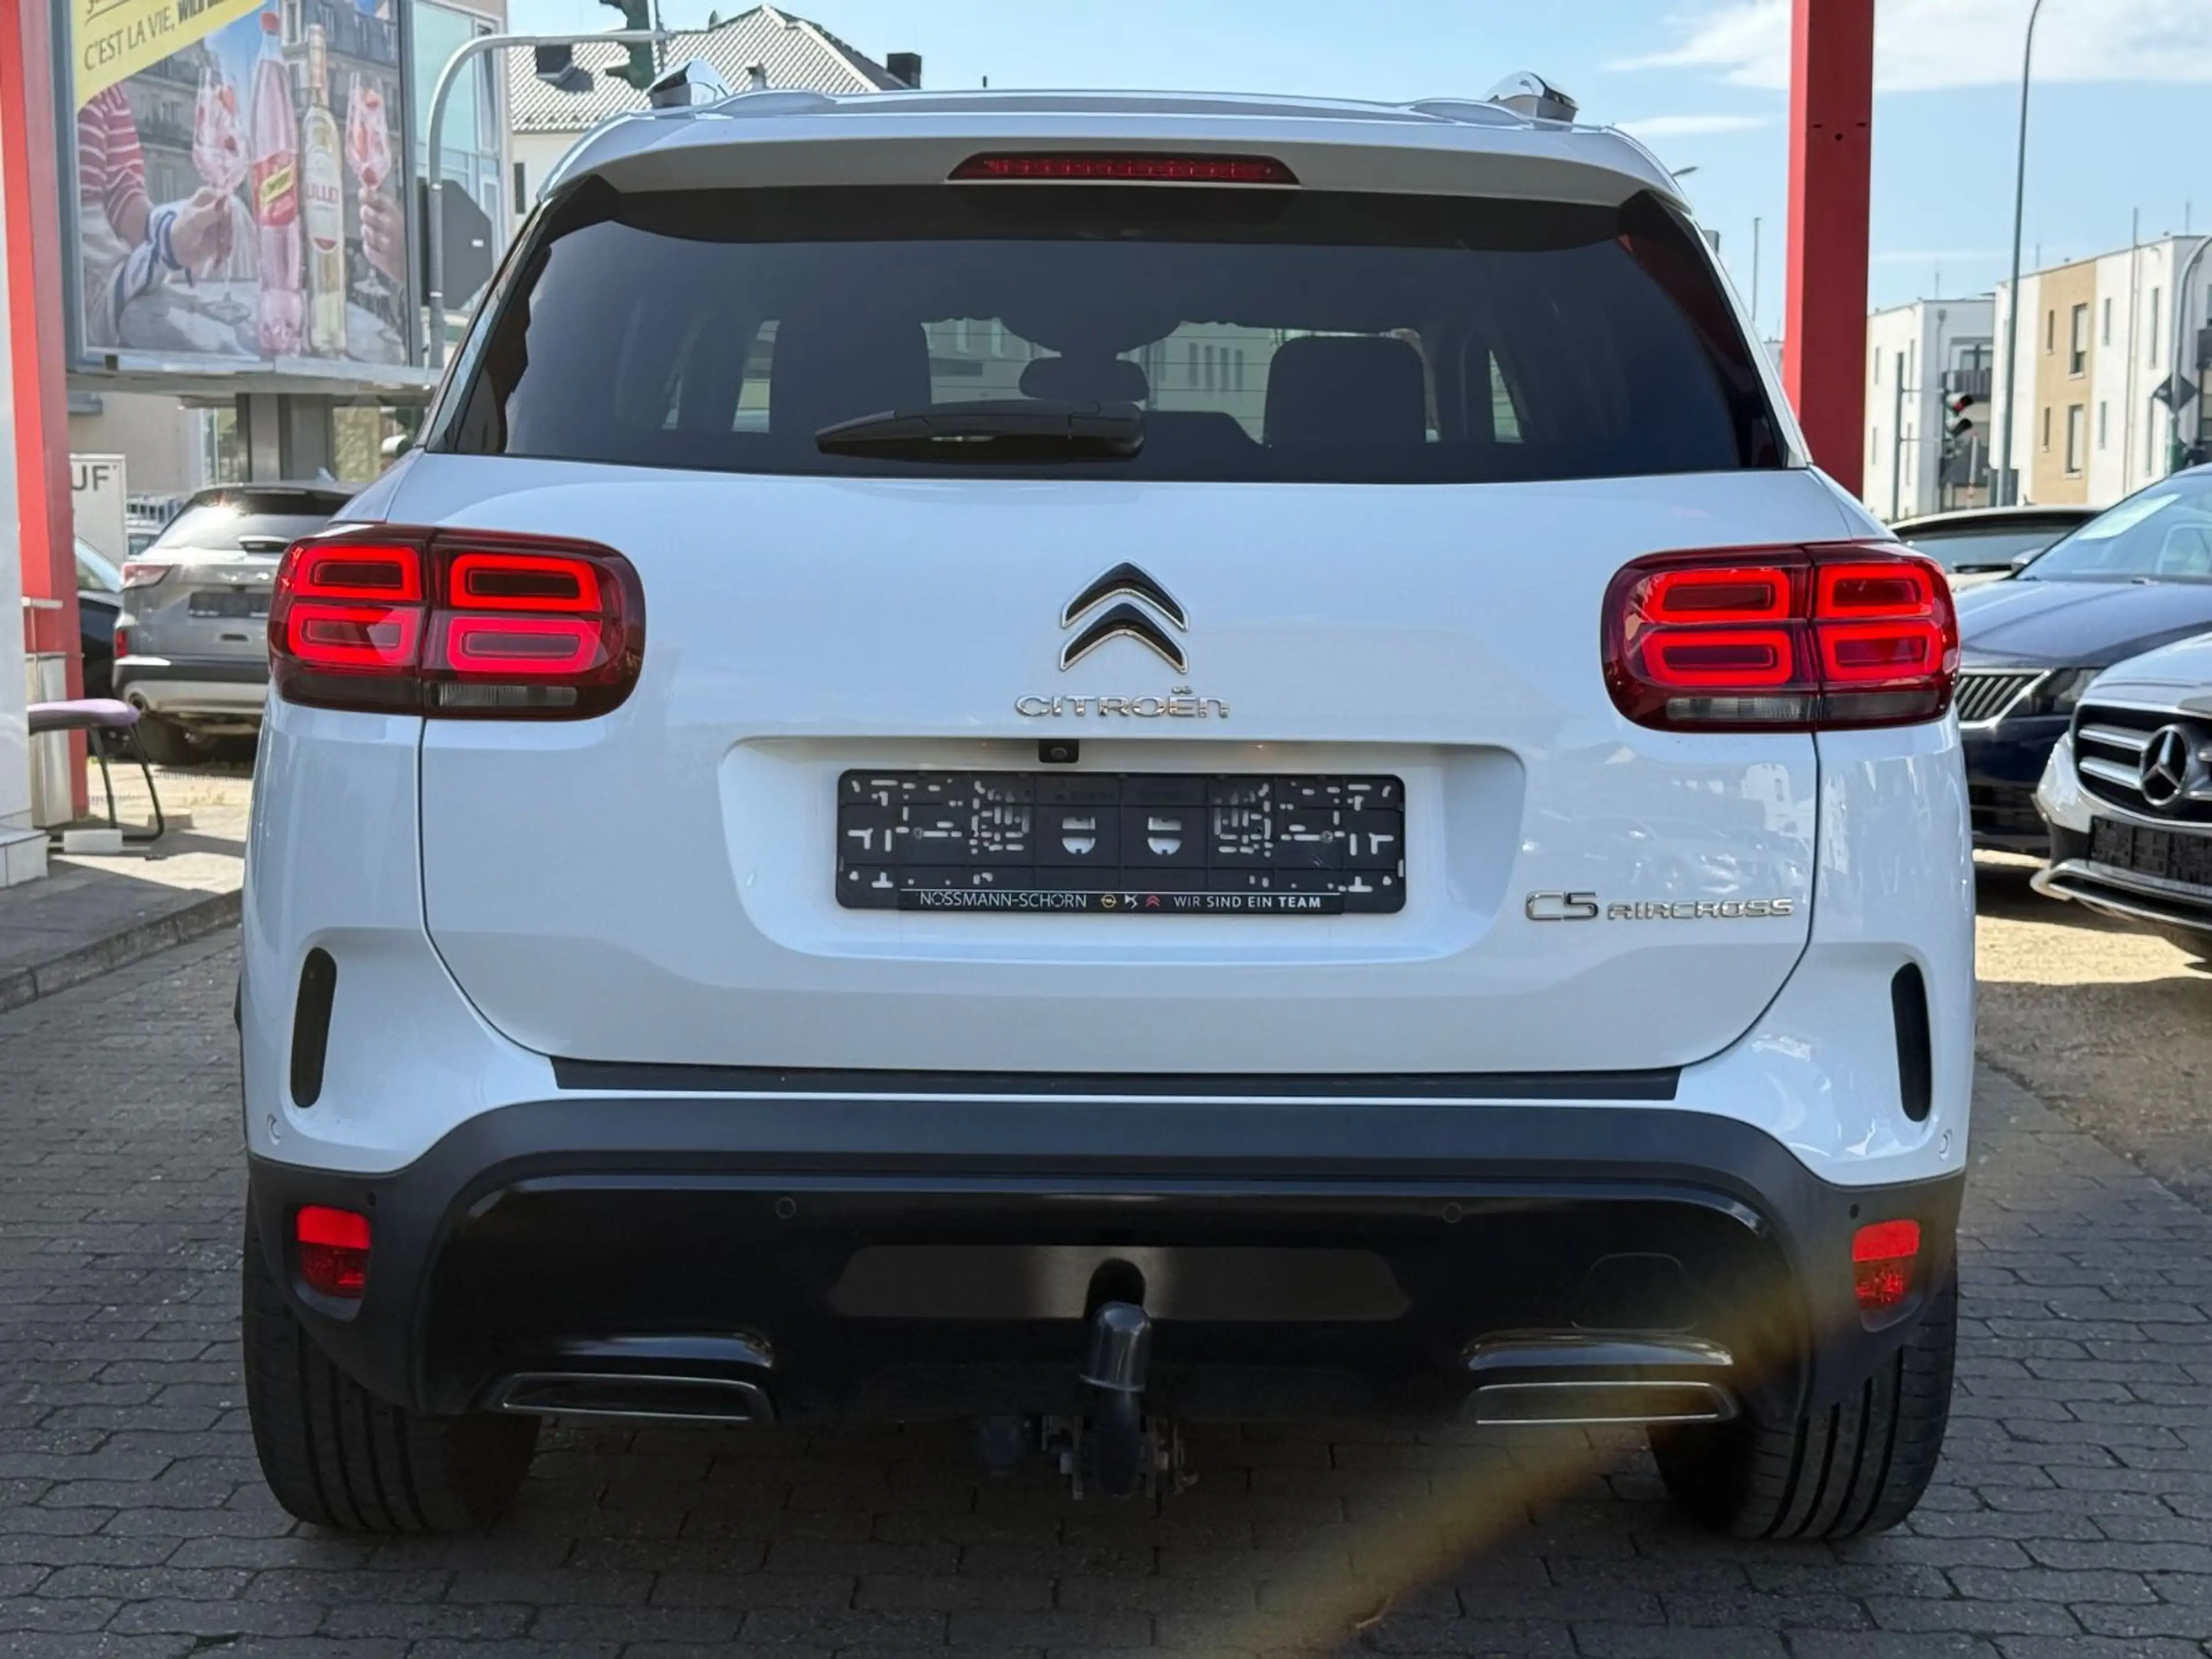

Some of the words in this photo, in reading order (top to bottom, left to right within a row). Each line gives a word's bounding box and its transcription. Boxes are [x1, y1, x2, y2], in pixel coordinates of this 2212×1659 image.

[84, 28, 124, 70] C'EST
[127, 20, 146, 50] LA
[147, 6, 175, 38] VIE,
[920, 892, 1087, 908] NOSSMANN-SCHORN
[1173, 896, 1201, 907] WIR
[1206, 896, 1242, 908] SIND
[1247, 896, 1272, 908] EIN
[1278, 896, 1321, 908] TEAM
[1526, 891, 1599, 921] C5
[1607, 897, 1795, 919] AIRCROSS
